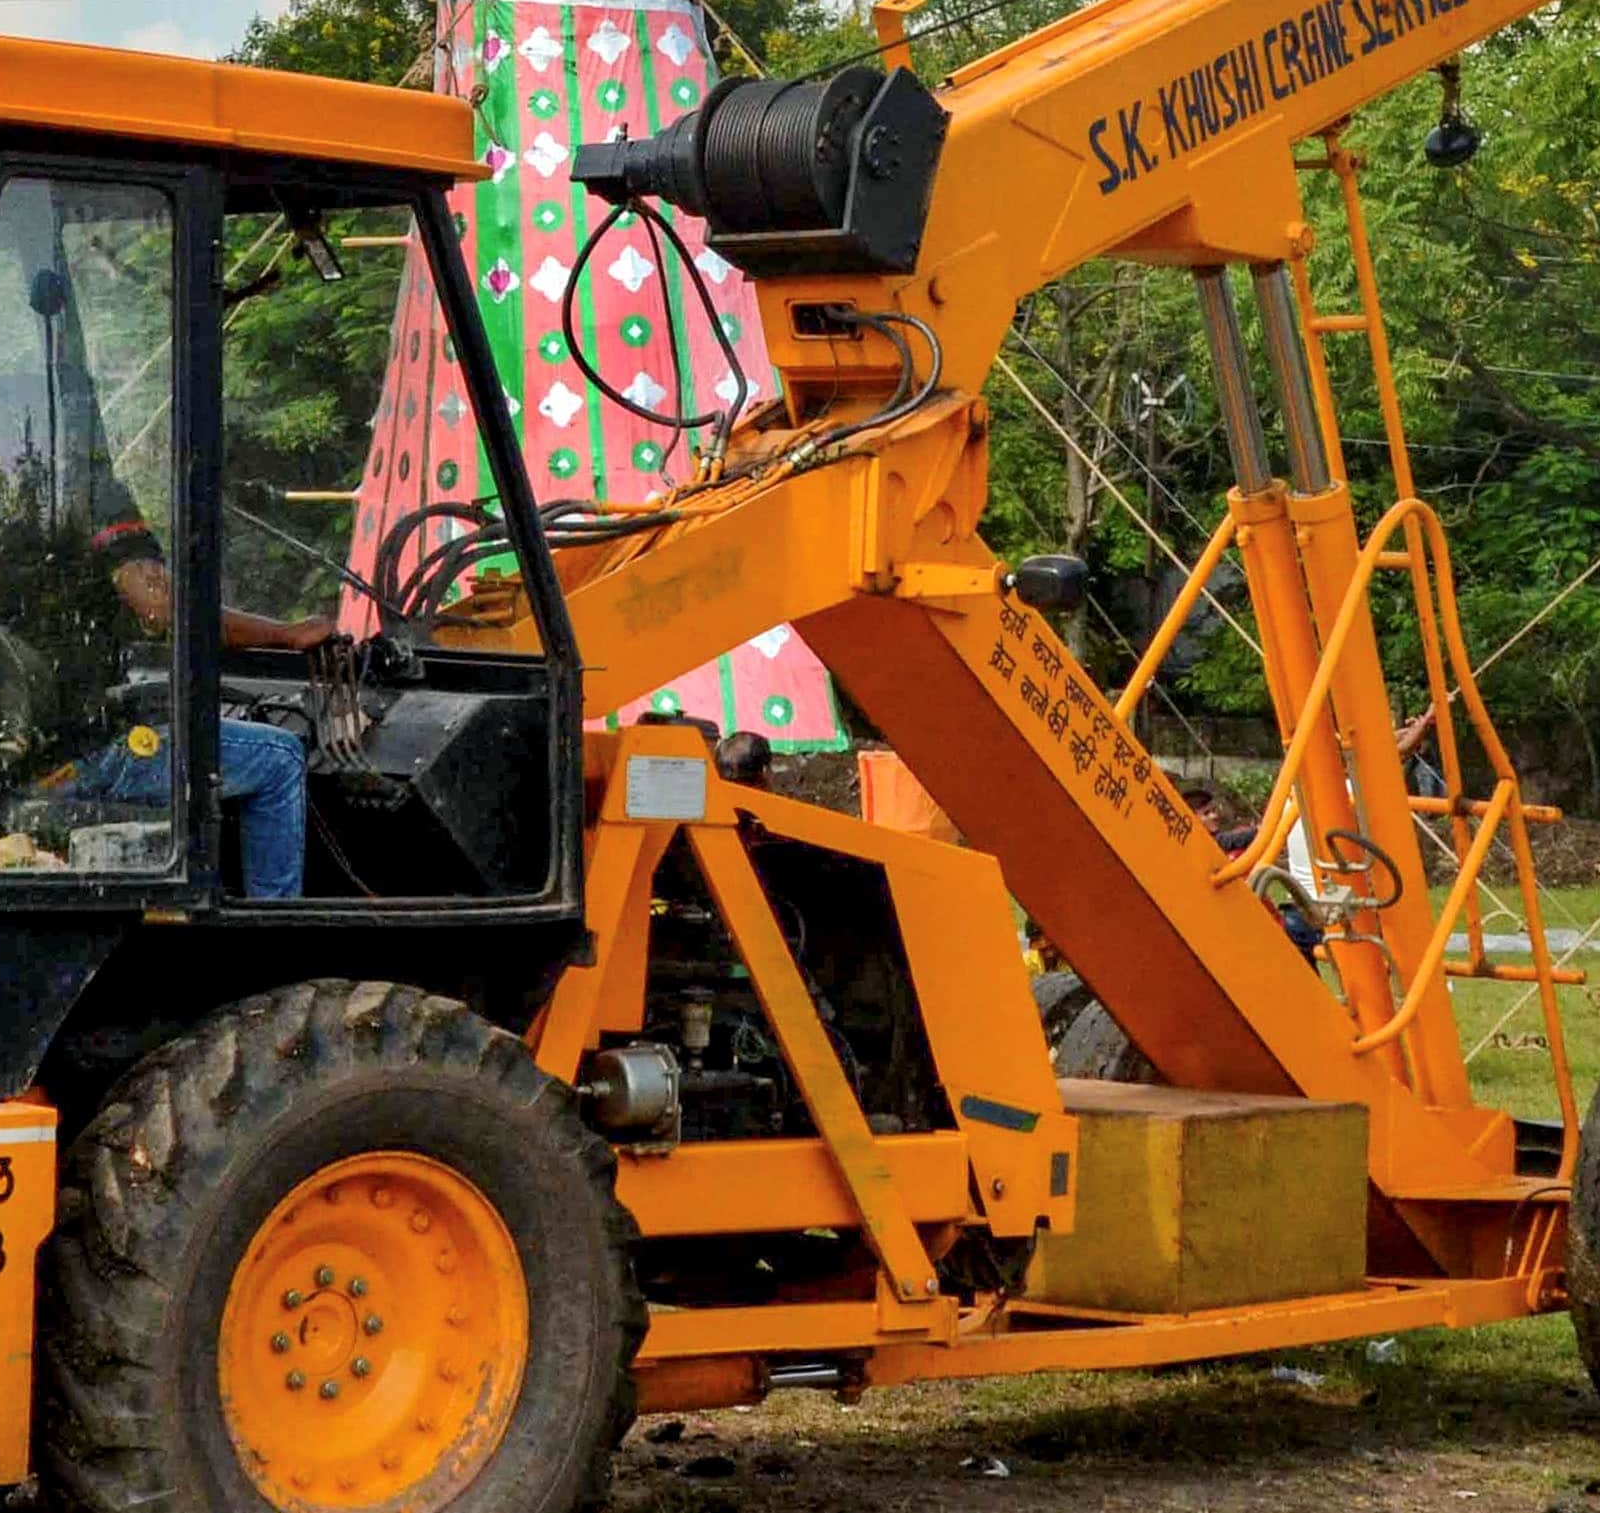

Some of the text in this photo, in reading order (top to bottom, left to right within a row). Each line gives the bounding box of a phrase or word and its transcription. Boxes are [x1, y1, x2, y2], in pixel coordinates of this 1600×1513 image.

[1089, 100, 1159, 195] S.K.
[1158, 39, 1266, 159] KHUSHI
[1032, 632, 1064, 681] करते
